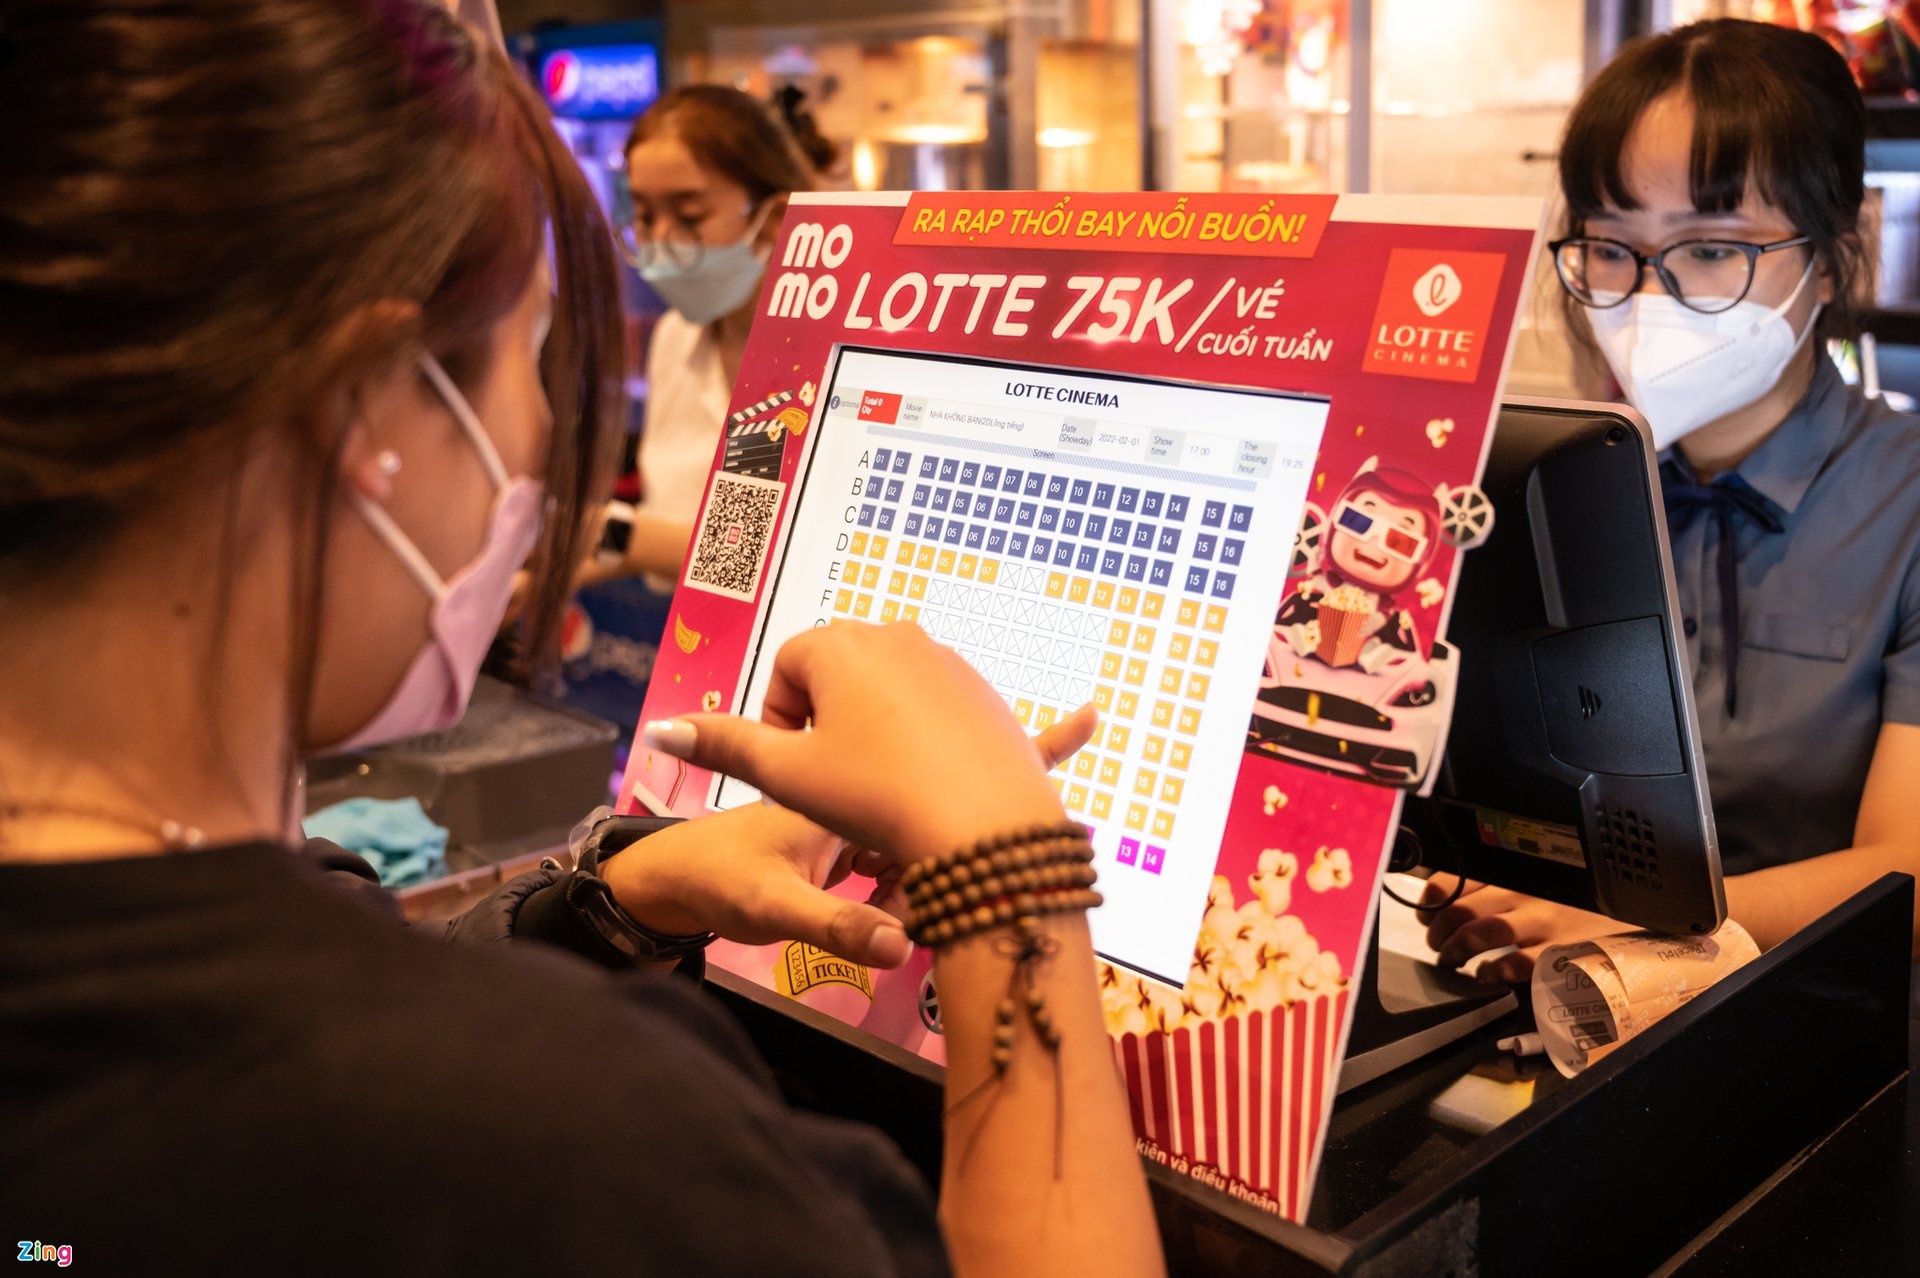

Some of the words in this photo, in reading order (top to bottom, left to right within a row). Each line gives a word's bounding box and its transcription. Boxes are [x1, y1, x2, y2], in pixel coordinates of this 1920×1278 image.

[912, 208, 946, 233] RA
[951, 208, 1005, 242] RẠP
[1010, 196, 1074, 236] THỔI
[1075, 210, 1136, 237] BAY
[1136, 197, 1196, 240] NỖI
[1198, 199, 1307, 243] BUỒN!
[843, 271, 1047, 337] LOTTE
[1236, 278, 1285, 319] VÉ
[1197, 325, 1258, 358] CUỐI
[1263, 328, 1333, 362] TUẦN
[1377, 324, 1475, 353] LOTTE
[1373, 348, 1467, 368] CINEMA
[1005, 382, 1055, 400] LOTTE
[1056, 388, 1119, 408] CINEMA
[903, 413, 919, 421] name
[906, 403, 923, 412] Movie
[1061, 424, 1077, 433] Date
[1059, 433, 1093, 447] (Showday)
[1099, 433, 1140, 446] 2022-02-01
[1153, 436, 1174, 446] Show
[1244, 441, 1258, 451] The
[1032, 449, 1056, 460] Screen
[1151, 447, 1167, 456] time
[1240, 453, 1268, 465] closing
[1238, 464, 1256, 475] hour
[858, 450, 869, 468] A
[876, 454, 885, 463] 01
[895, 457, 905, 467] 02
[922, 461, 932, 472] 03
[942, 465, 952, 475] 04
[963, 468, 973, 478] 05
[984, 472, 994, 482] 06
[1005, 475, 1016, 485] 07
[1027, 479, 1038, 489] 08
[1050, 482, 1061, 493] 09
[1074, 486, 1084, 497] 10
[1097, 490, 1106, 500] 11
[1122, 494, 1132, 505] 12
[1146, 498, 1156, 509] 13
[1171, 502, 1181, 513] 14
[1206, 508, 1217, 519] 15
[1233, 512, 1244, 524] 16
[851, 478, 862, 496] B
[868, 482, 877, 492] 01
[887, 486, 897, 496] 02
[914, 491, 924, 501] 03
[934, 494, 944, 504] 04
[954, 498, 965, 508] 05
[976, 502, 986, 512] 06
[997, 505, 1008, 515] 07
[1019, 509, 1030, 520] 08
[1042, 513, 1052, 524] 09
[1066, 518, 1075, 528] 10
[1089, 522, 1098, 532] 11
[1113, 526, 1123, 537] 12
[1137, 530, 1148, 542] 13
[1162, 535, 1172, 546] 14
[1198, 541, 1208, 553] 15
[1225, 546, 1235, 558] 16
[836, 533, 849, 552] D
[844, 506, 856, 524] C
[860, 510, 869, 520] 01
[879, 514, 889, 524] 02
[907, 519, 917, 530] 03
[926, 523, 936, 533] 04
[947, 527, 957, 538] 05
[968, 531, 978, 542] 06
[989, 535, 1000, 545] 07
[1011, 539, 1022, 550] 08
[1033, 544, 1045, 555] 09
[1057, 549, 1067, 559] 10
[1081, 553, 1090, 564] 11
[1105, 558, 1115, 569] 12
[1129, 562, 1139, 574] 13
[1154, 567, 1164, 578] 14
[1189, 574, 1200, 586] 15
[1216, 579, 1227, 591] 16
[828, 562, 841, 581] E
[820, 589, 833, 607] F
[1121, 844, 1132, 857] 13
[1146, 852, 1157, 865] 14
[791, 948, 806, 988] 123456
[812, 962, 857, 982] TICKET
[1563, 1005, 1591, 1017] LOTTE
[1170, 1155, 1189, 1175] và
[1191, 1164, 1226, 1191] điều
[1228, 1179, 1279, 1215] khoản
